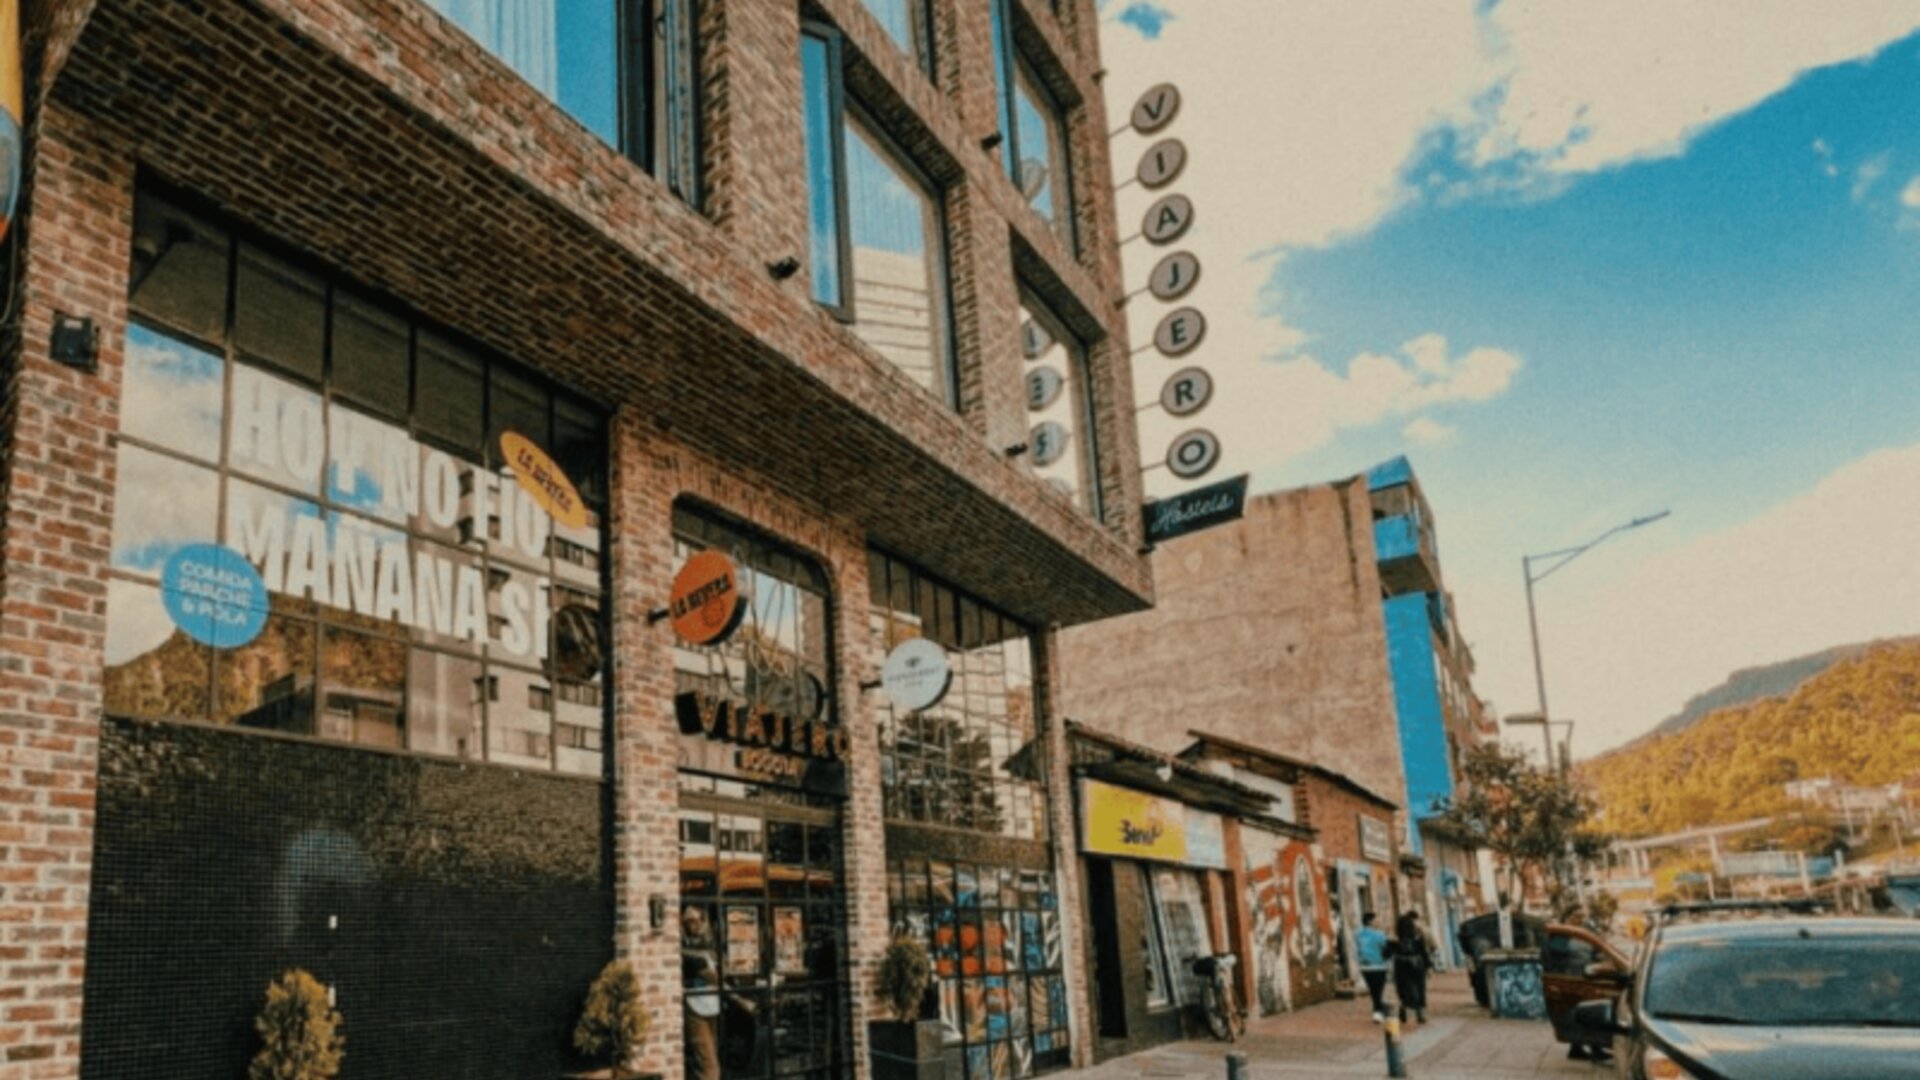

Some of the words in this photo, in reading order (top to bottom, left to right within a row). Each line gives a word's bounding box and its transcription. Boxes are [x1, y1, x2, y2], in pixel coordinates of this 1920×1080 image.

[1141, 91, 1207, 467] VIAJERO
[233, 372, 368, 491] HOY
[380, 422, 460, 528] NO
[1150, 492, 1235, 533] Hostels
[181, 561, 253, 592] COMIDA
